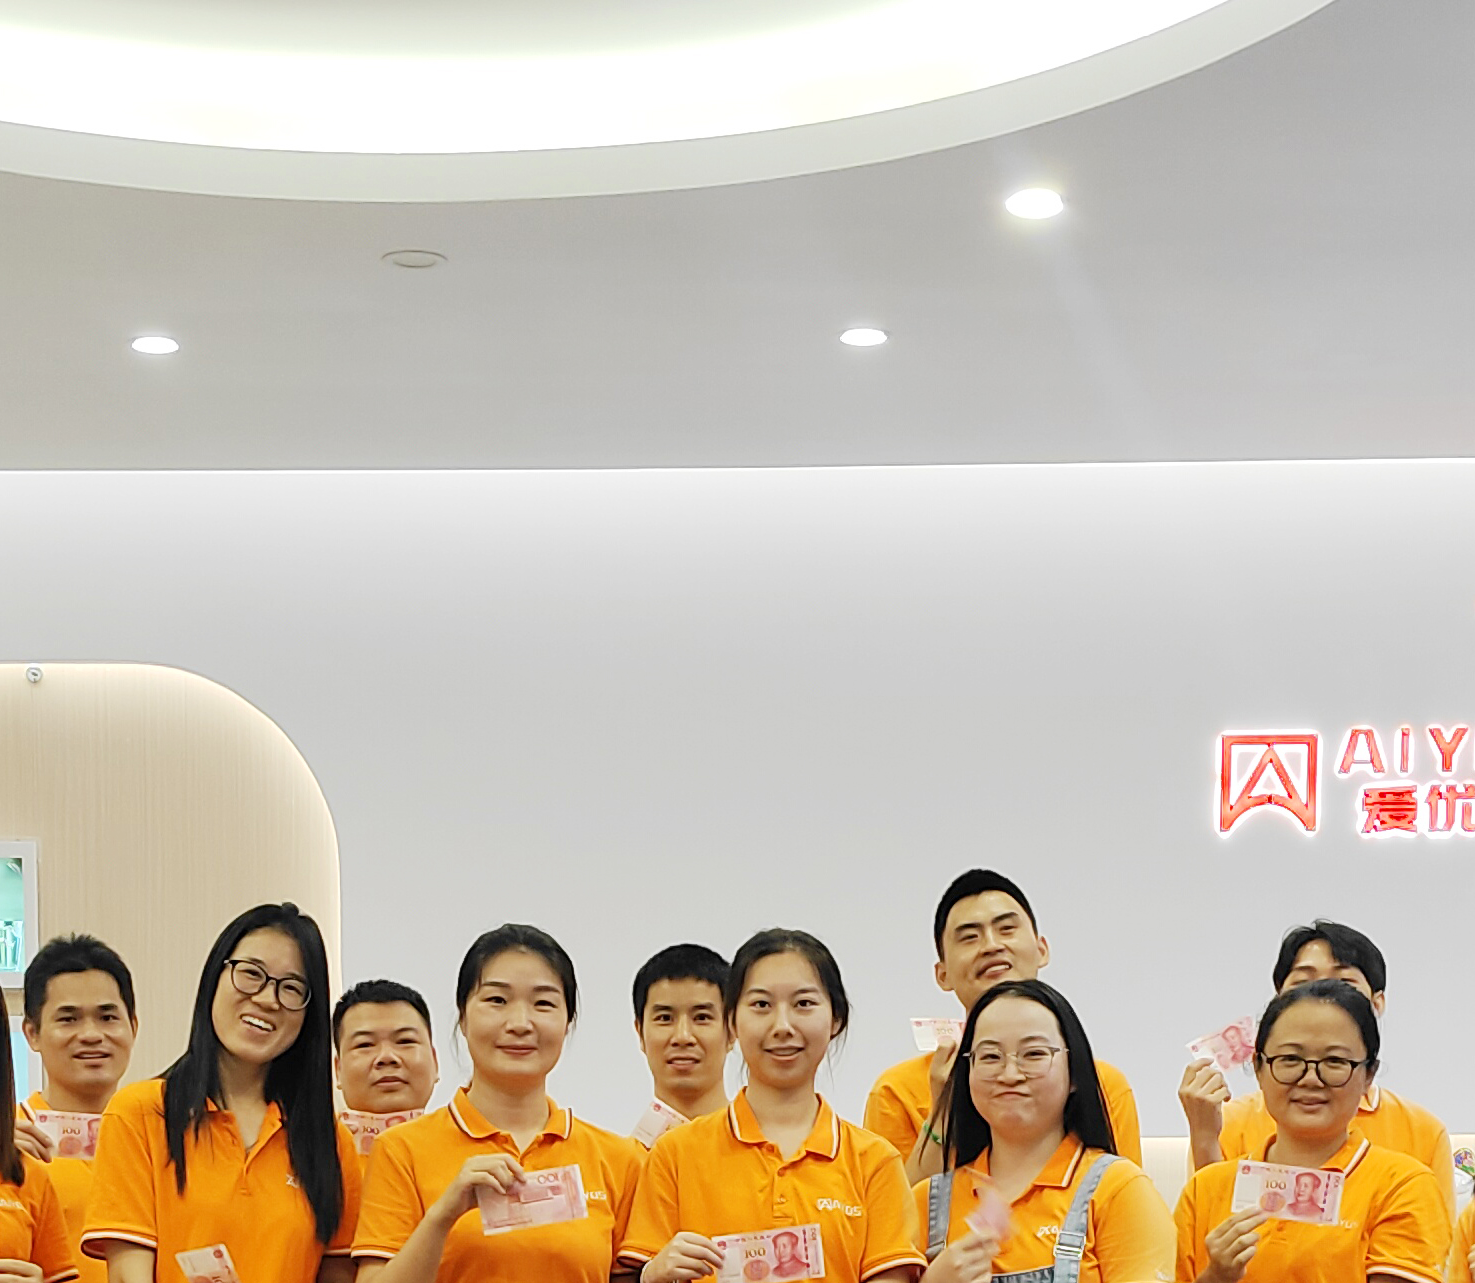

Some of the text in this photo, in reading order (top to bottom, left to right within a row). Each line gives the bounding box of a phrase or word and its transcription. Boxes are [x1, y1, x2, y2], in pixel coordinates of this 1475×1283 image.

[62, 1126, 81, 1136] 100
[1265, 1180, 1287, 1190] 100
[745, 1248, 766, 1258] 100
